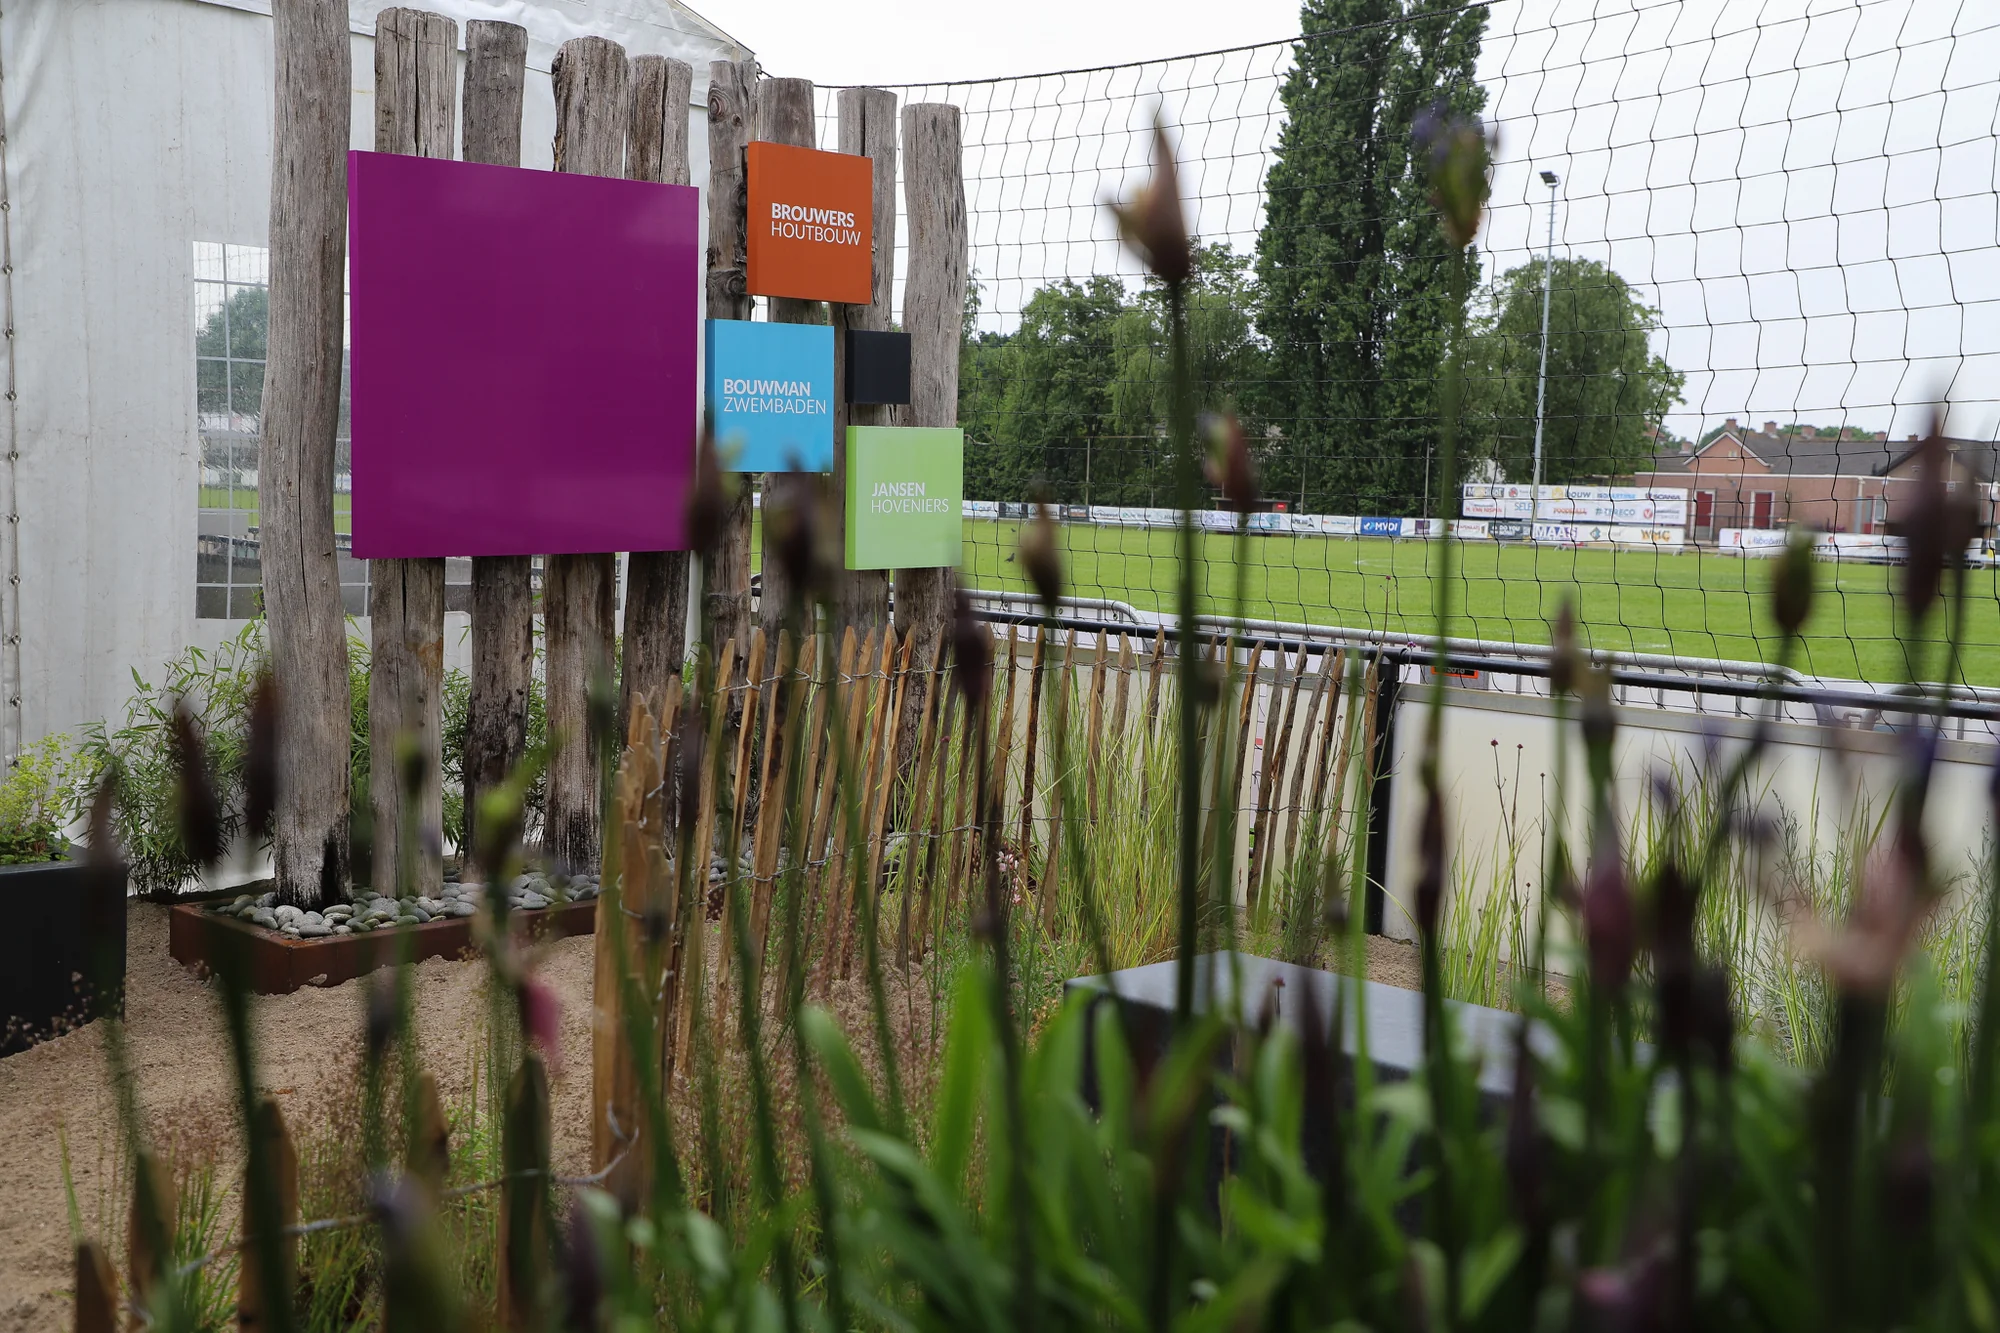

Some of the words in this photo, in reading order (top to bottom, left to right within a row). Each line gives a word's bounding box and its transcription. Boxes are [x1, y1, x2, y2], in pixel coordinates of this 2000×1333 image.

[771, 202, 855, 228] BROUWERS
[771, 221, 861, 246] HOUTBOUW
[723, 378, 811, 397] BOUWMAN
[723, 396, 826, 415] ZWEMBADEN
[871, 482, 926, 497] JANSEN
[871, 498, 949, 515] HOVENIERS
[1375, 522, 1398, 531] MVDI
[1535, 525, 1578, 538] MAAS
